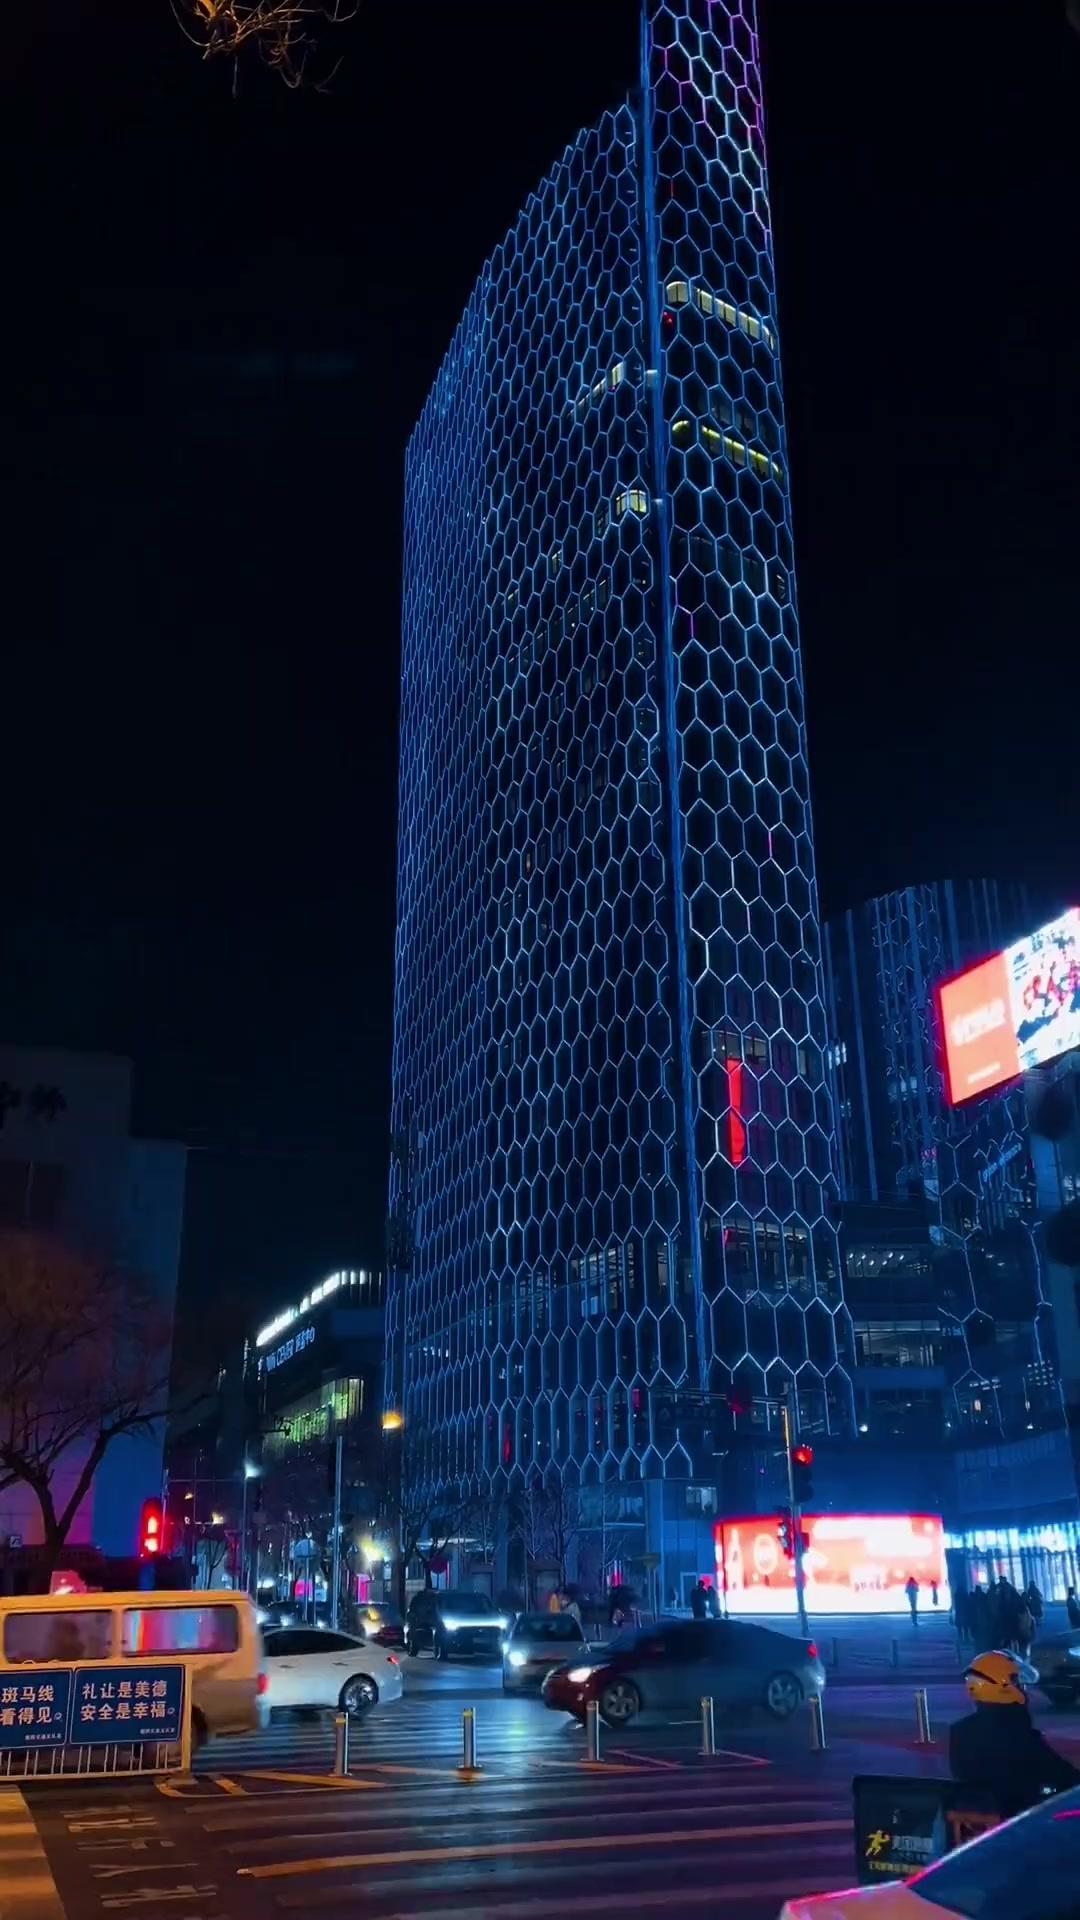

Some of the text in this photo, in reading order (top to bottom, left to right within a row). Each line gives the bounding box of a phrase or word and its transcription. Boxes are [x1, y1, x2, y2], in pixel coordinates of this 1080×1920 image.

[2, 1685, 54, 1702] 斑马线
[82, 1680, 168, 1699] 礼让是美德
